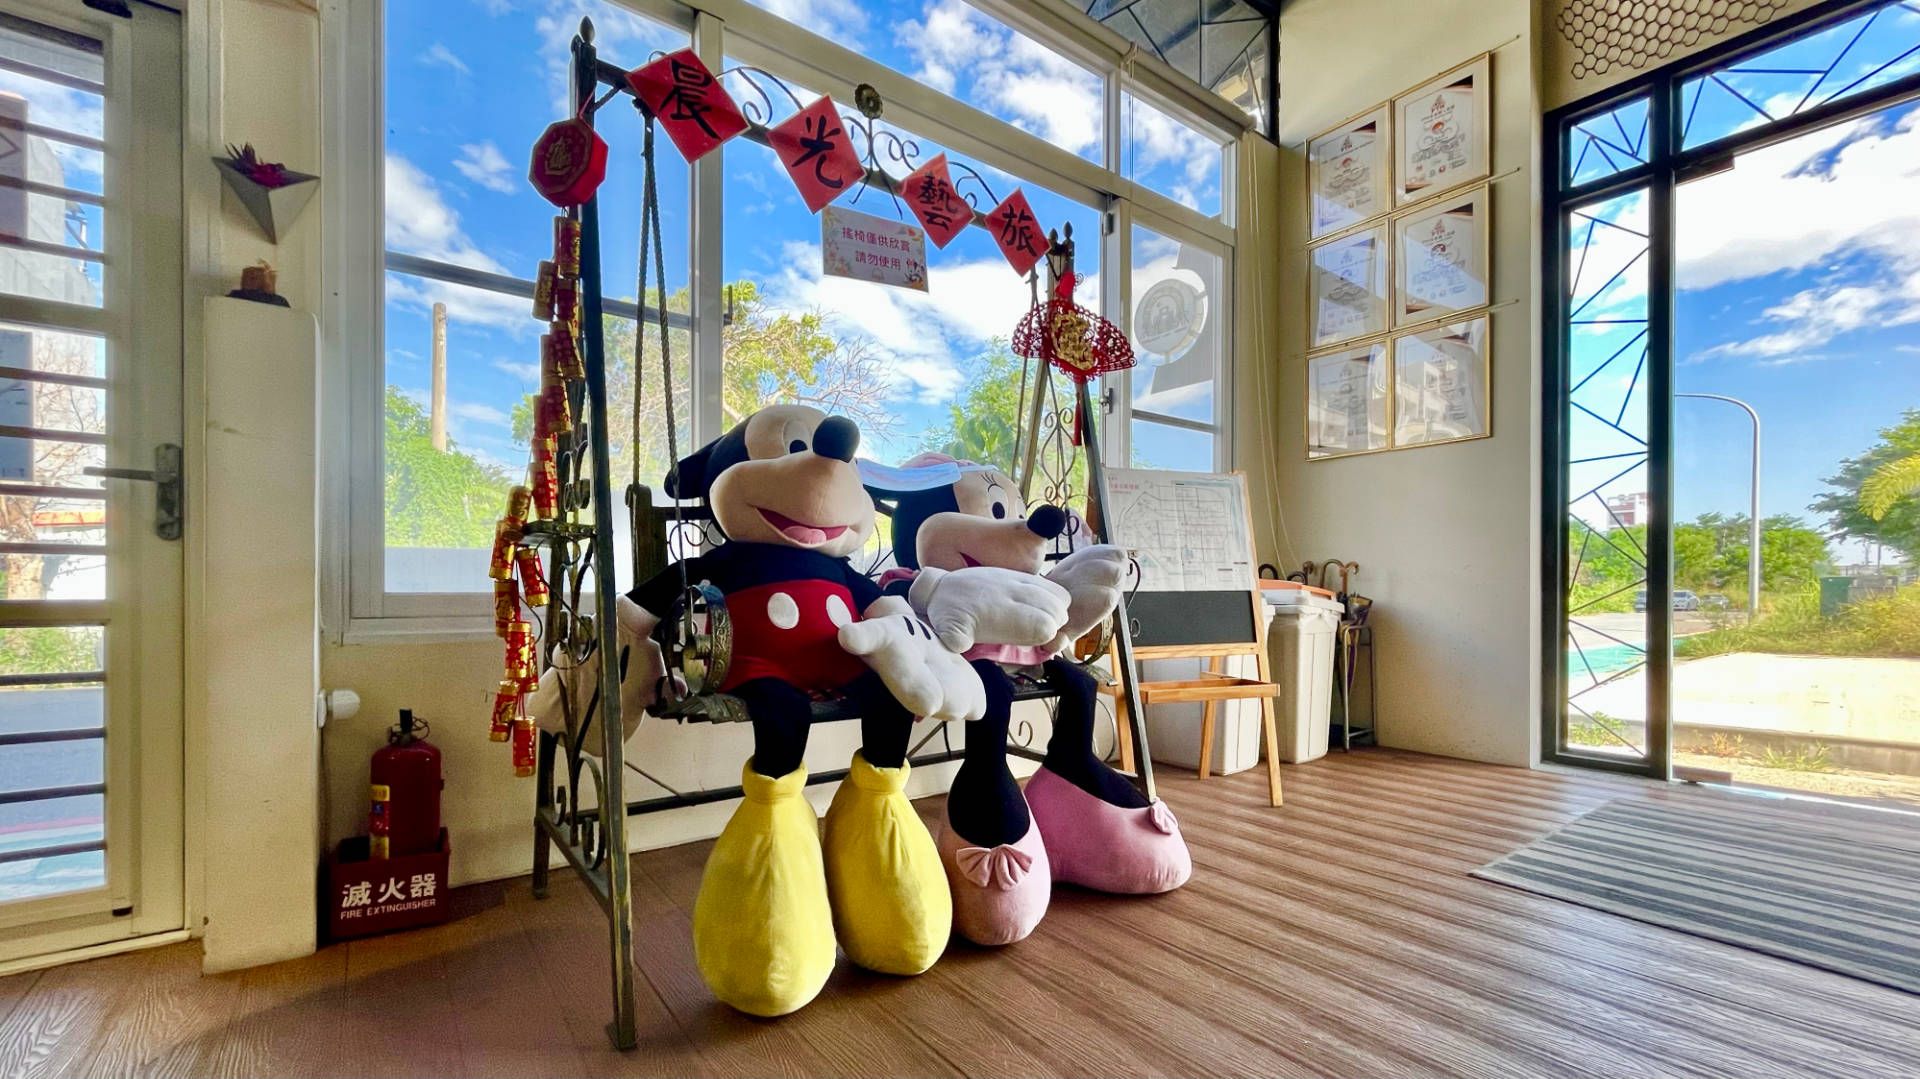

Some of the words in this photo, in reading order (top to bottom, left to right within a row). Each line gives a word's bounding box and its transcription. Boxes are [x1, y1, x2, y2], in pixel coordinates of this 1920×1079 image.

[658, 59, 723, 141] 晨
[791, 114, 844, 189] 光
[917, 171, 958, 232] 藝
[1001, 203, 1038, 258] 旅
[855, 249, 902, 271] 請勿使用
[341, 872, 437, 909] 滅火器
[340, 908, 363, 920] FIRE
[366, 898, 437, 916] EXTINGUISHER
